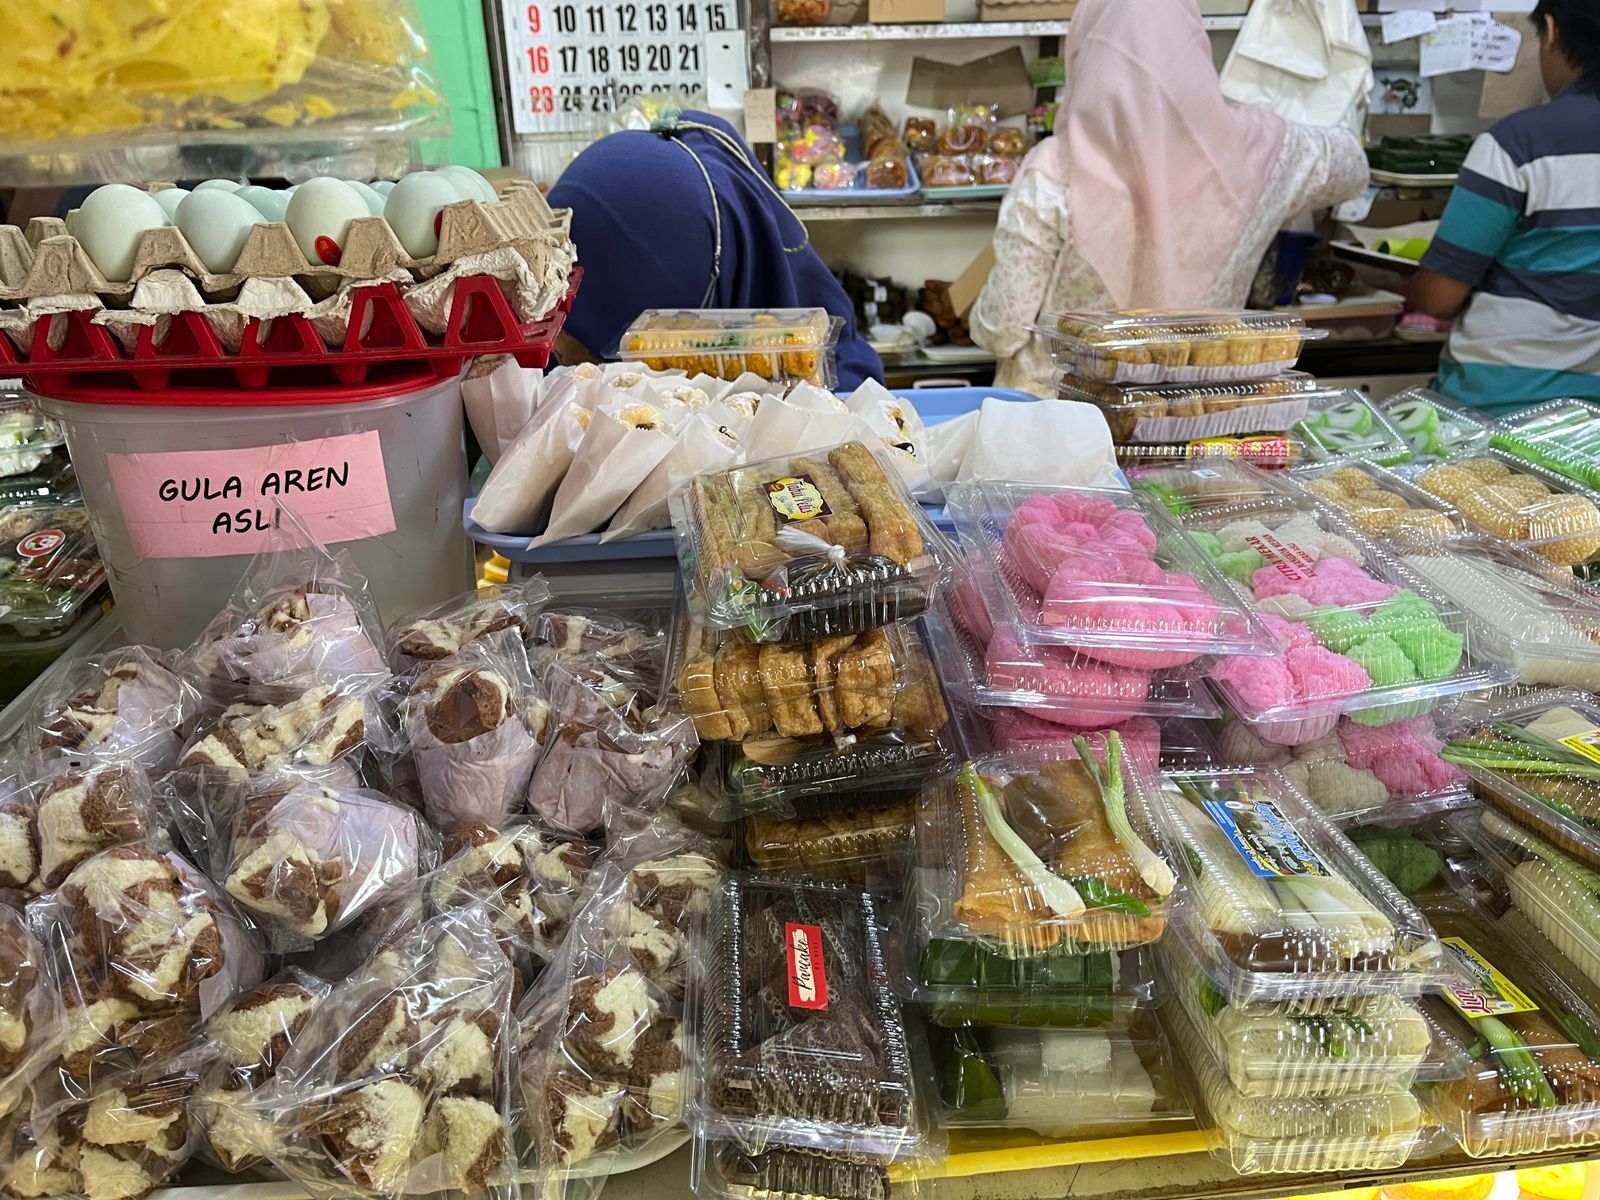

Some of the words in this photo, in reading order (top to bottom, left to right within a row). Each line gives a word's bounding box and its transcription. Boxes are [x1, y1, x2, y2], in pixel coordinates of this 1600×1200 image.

[527, 5, 541, 34] 9
[553, 5, 576, 32] 10
[586, 5, 605, 32] 11
[616, 4, 637, 31] 12
[645, 4, 667, 31] 13
[676, 4, 697, 31] 14
[705, 4, 725, 31] 15
[527, 46, 549, 74] 16
[559, 46, 577, 72] 17
[588, 46, 609, 72] 18
[617, 45, 640, 71] 19
[647, 45, 671, 71] 20
[679, 44, 699, 70] 21
[529, 86, 554, 113] 23
[560, 85, 583, 112] 24
[158, 476, 242, 502] GULA
[261, 462, 349, 497] AREN
[212, 507, 281, 535] ASLI
[1245, 536, 1277, 560] MEKAR
[1272, 559, 1302, 581] CITRA
[789, 938, 813, 991] Pancake
